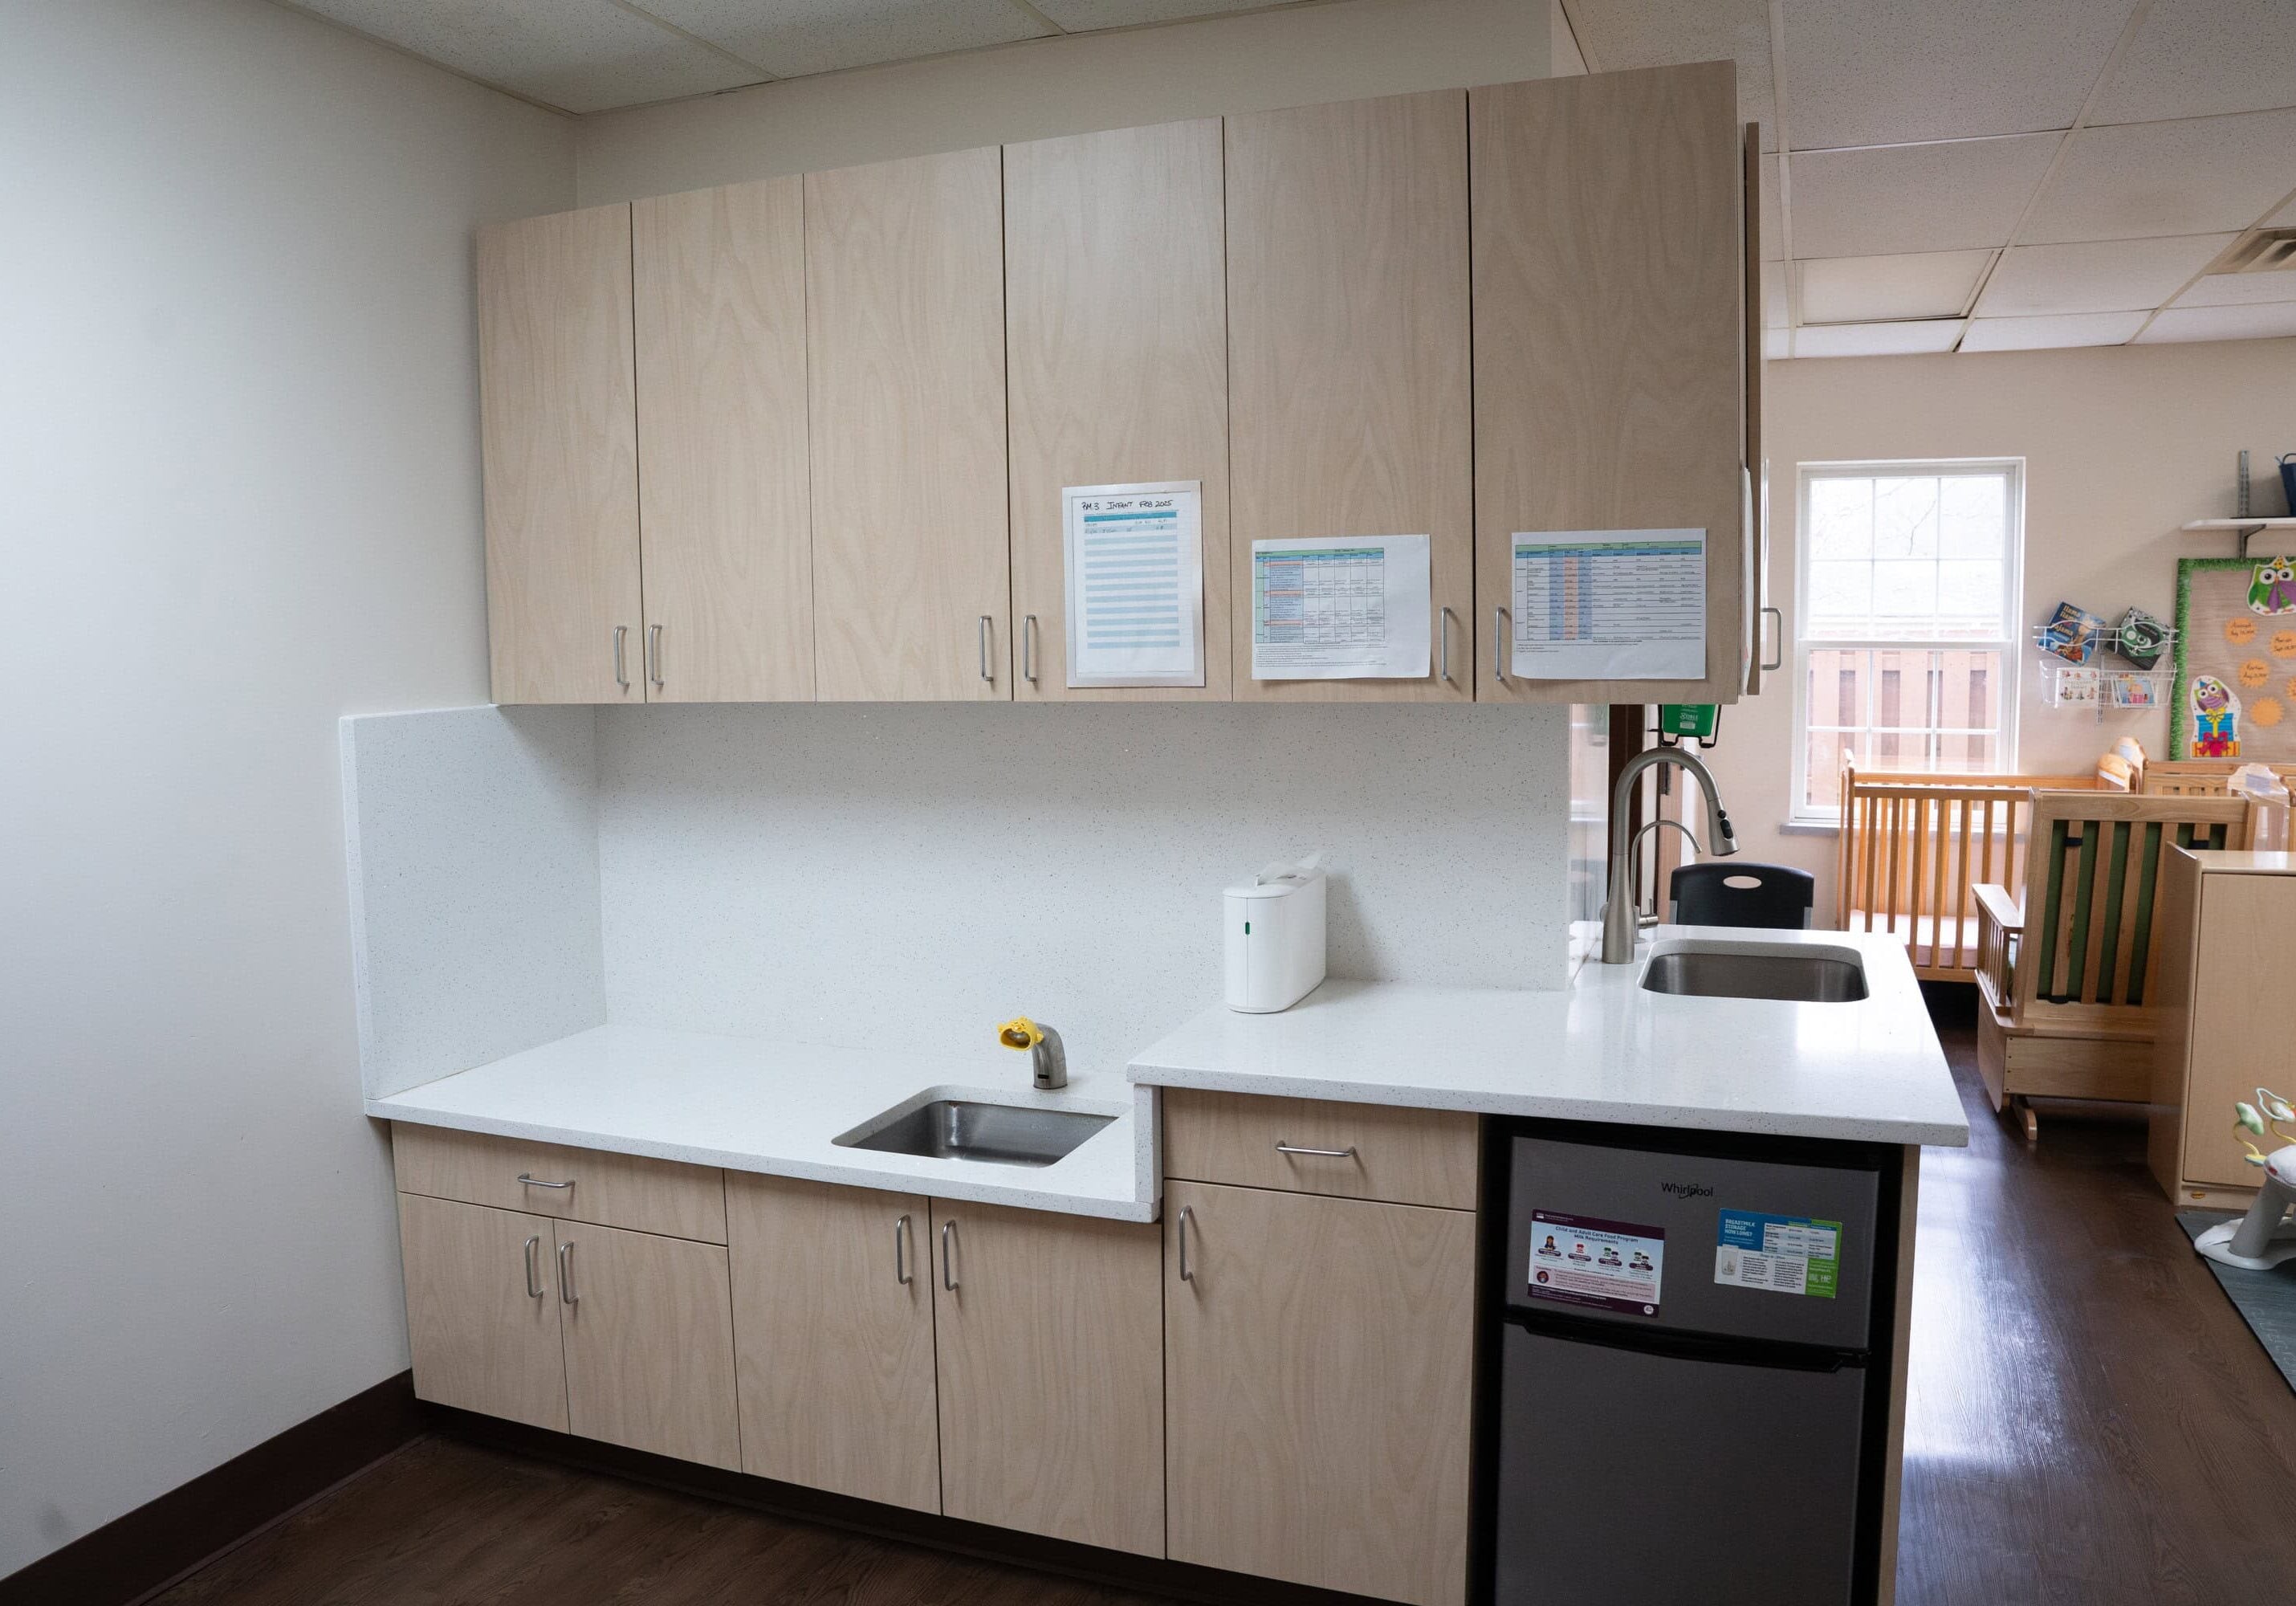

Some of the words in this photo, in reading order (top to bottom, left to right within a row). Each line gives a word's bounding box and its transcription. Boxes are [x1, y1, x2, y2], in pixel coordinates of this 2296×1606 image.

[1106, 501, 1133, 510] INFANT
[1155, 499, 1174, 507] 2025
[1661, 1182, 1714, 1199] Whirlpool
[1725, 1219, 1757, 1228] BREASTMILK
[1585, 1236, 1618, 1245] Requirements
[1617, 1235, 1639, 1244] Program
